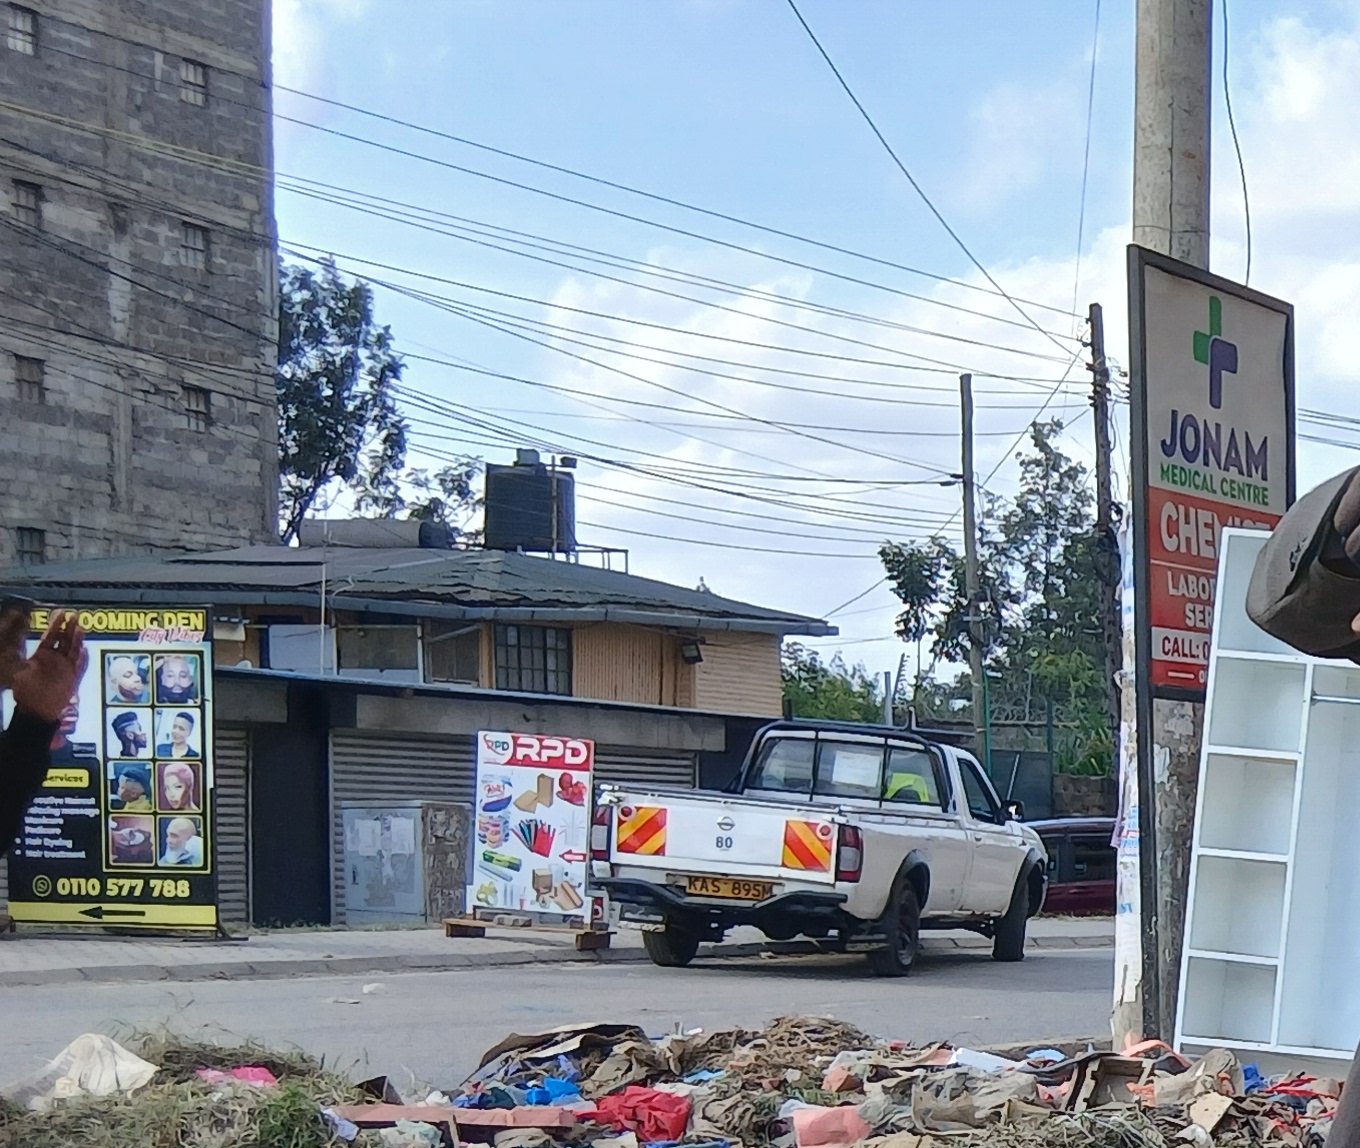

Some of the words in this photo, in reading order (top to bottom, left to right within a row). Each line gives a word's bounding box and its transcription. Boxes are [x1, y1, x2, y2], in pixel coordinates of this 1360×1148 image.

[1160, 408, 1269, 482] JONAM
[1160, 462, 1217, 493] MEDICAL
[1220, 478, 1269, 506] CENTRE
[163, 611, 206, 631] DEN
[1162, 635, 1200, 660] CALL:
[515, 736, 588, 765] RPD
[715, 836, 733, 849] 80
[56, 877, 101, 896] 0110
[106, 878, 145, 896] 577
[150, 878, 190, 898] 788
[687, 876, 721, 893] KAS
